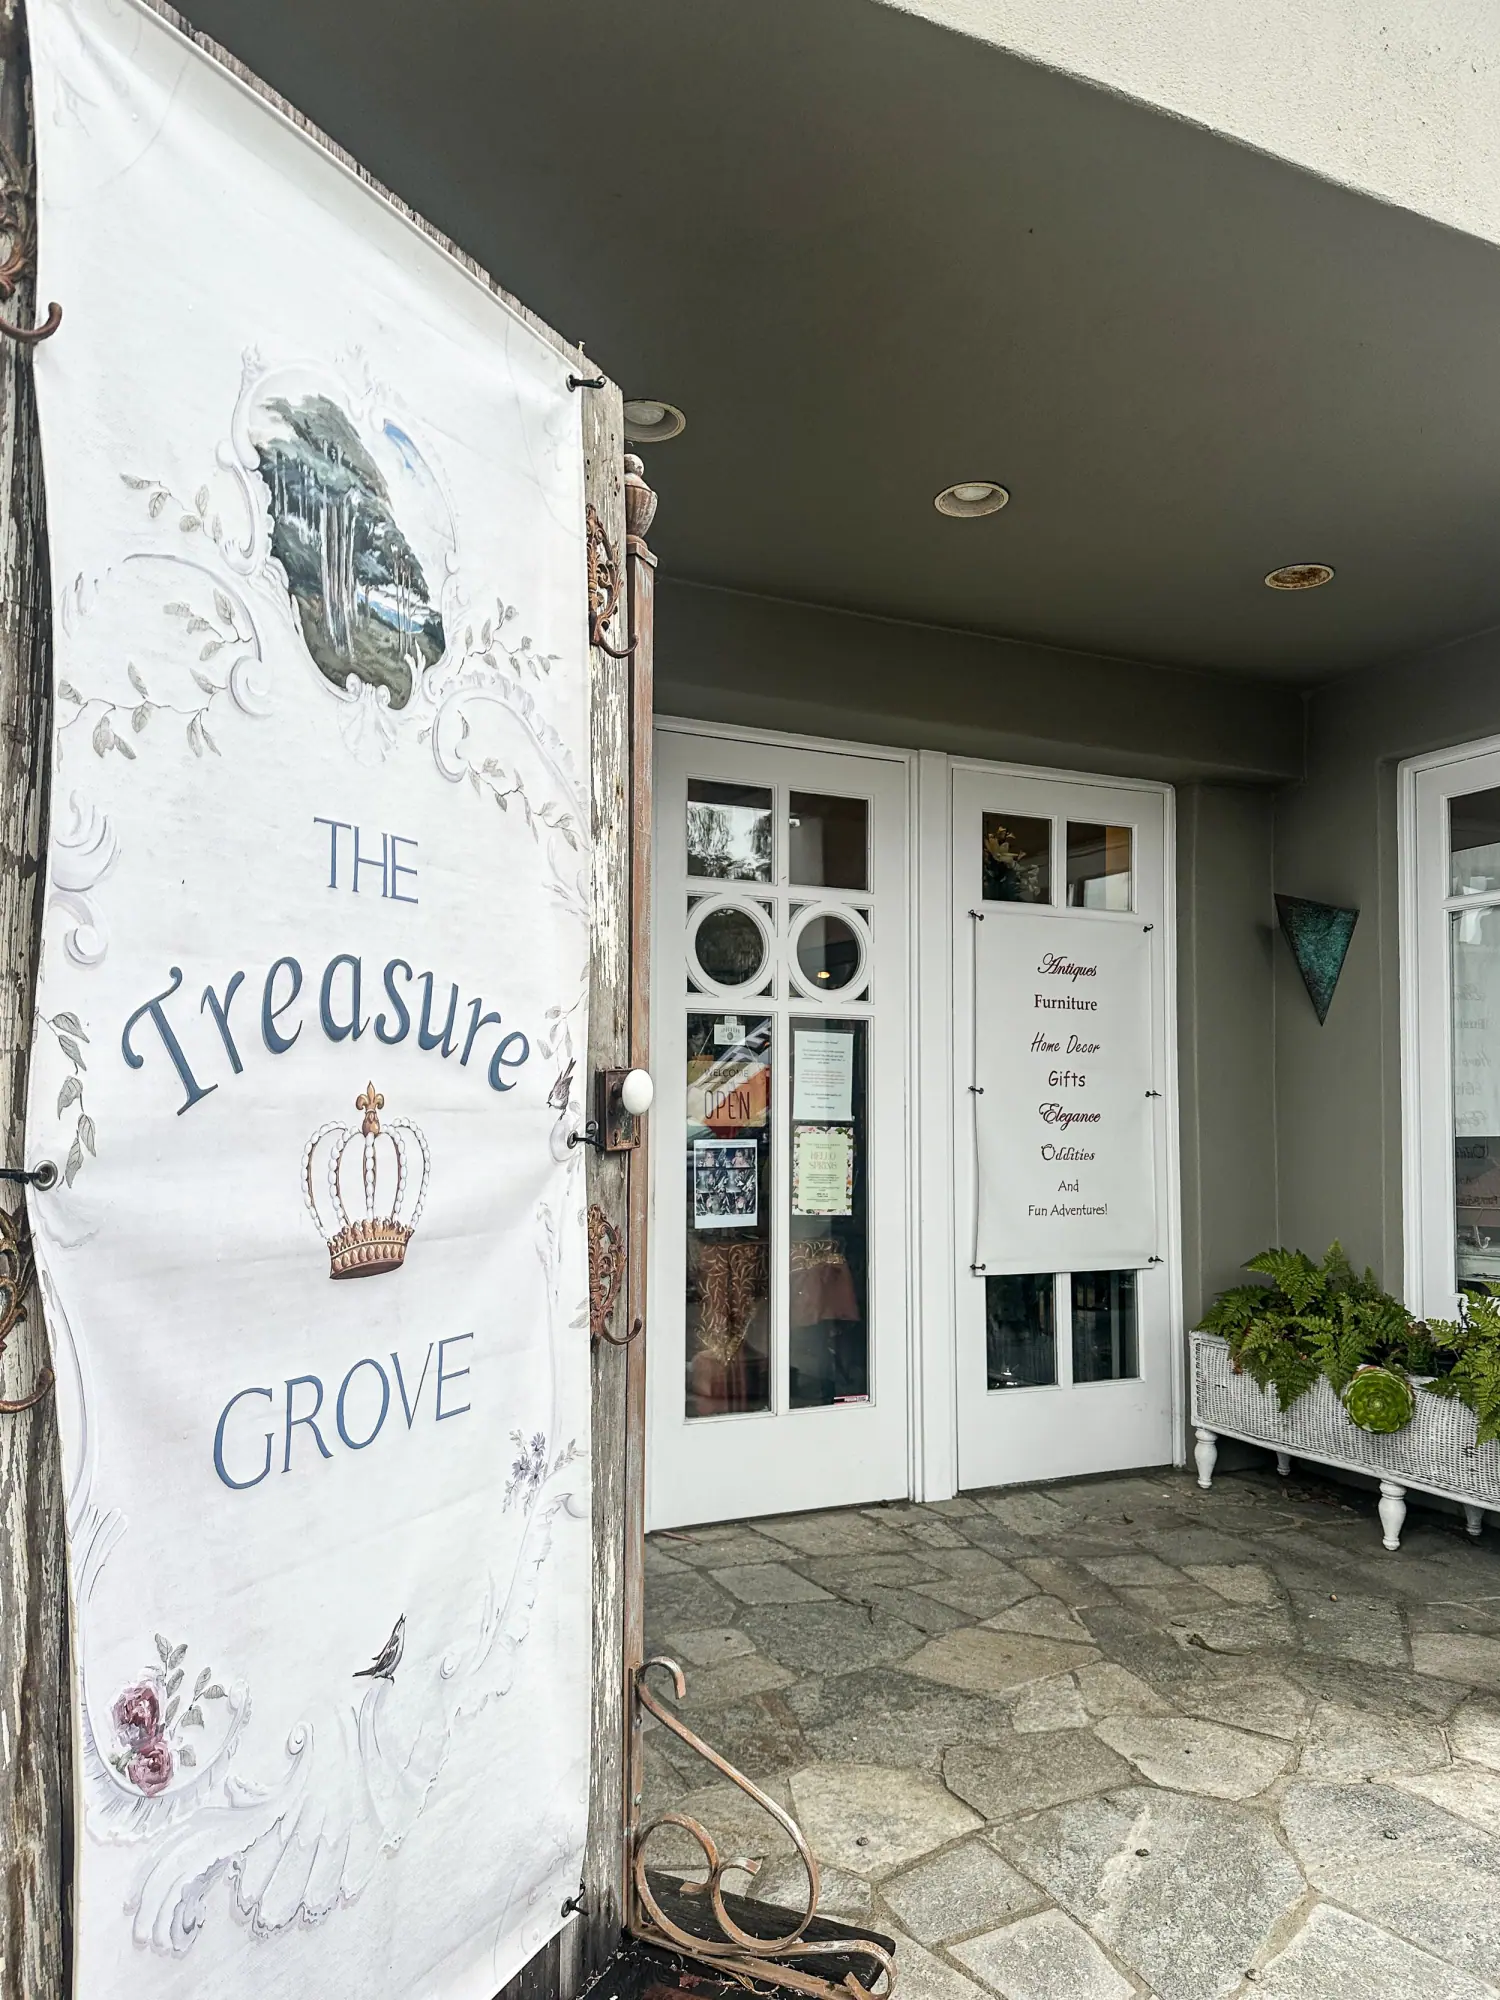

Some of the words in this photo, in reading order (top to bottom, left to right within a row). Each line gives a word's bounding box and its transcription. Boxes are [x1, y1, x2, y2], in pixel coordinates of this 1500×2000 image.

[314, 816, 419, 904] THE
[1037, 952, 1097, 982] Antiques
[1033, 994, 1098, 1011] Furniture
[121, 953, 531, 1116] Treasure
[1030, 1031, 1061, 1054] Home
[1065, 1034, 1101, 1054] Decor
[704, 1068, 749, 1078] WELCOME
[1048, 1070, 1086, 1087] Gifts
[704, 1090, 750, 1120] OPEN
[1038, 1102, 1101, 1131] Elegance
[1040, 1143, 1096, 1161] Oddities
[1057, 1179, 1080, 1192] And
[1028, 1204, 1048, 1217] Fun
[1050, 1203, 1108, 1217] Adventures!
[213, 1332, 474, 1490] GROVE
